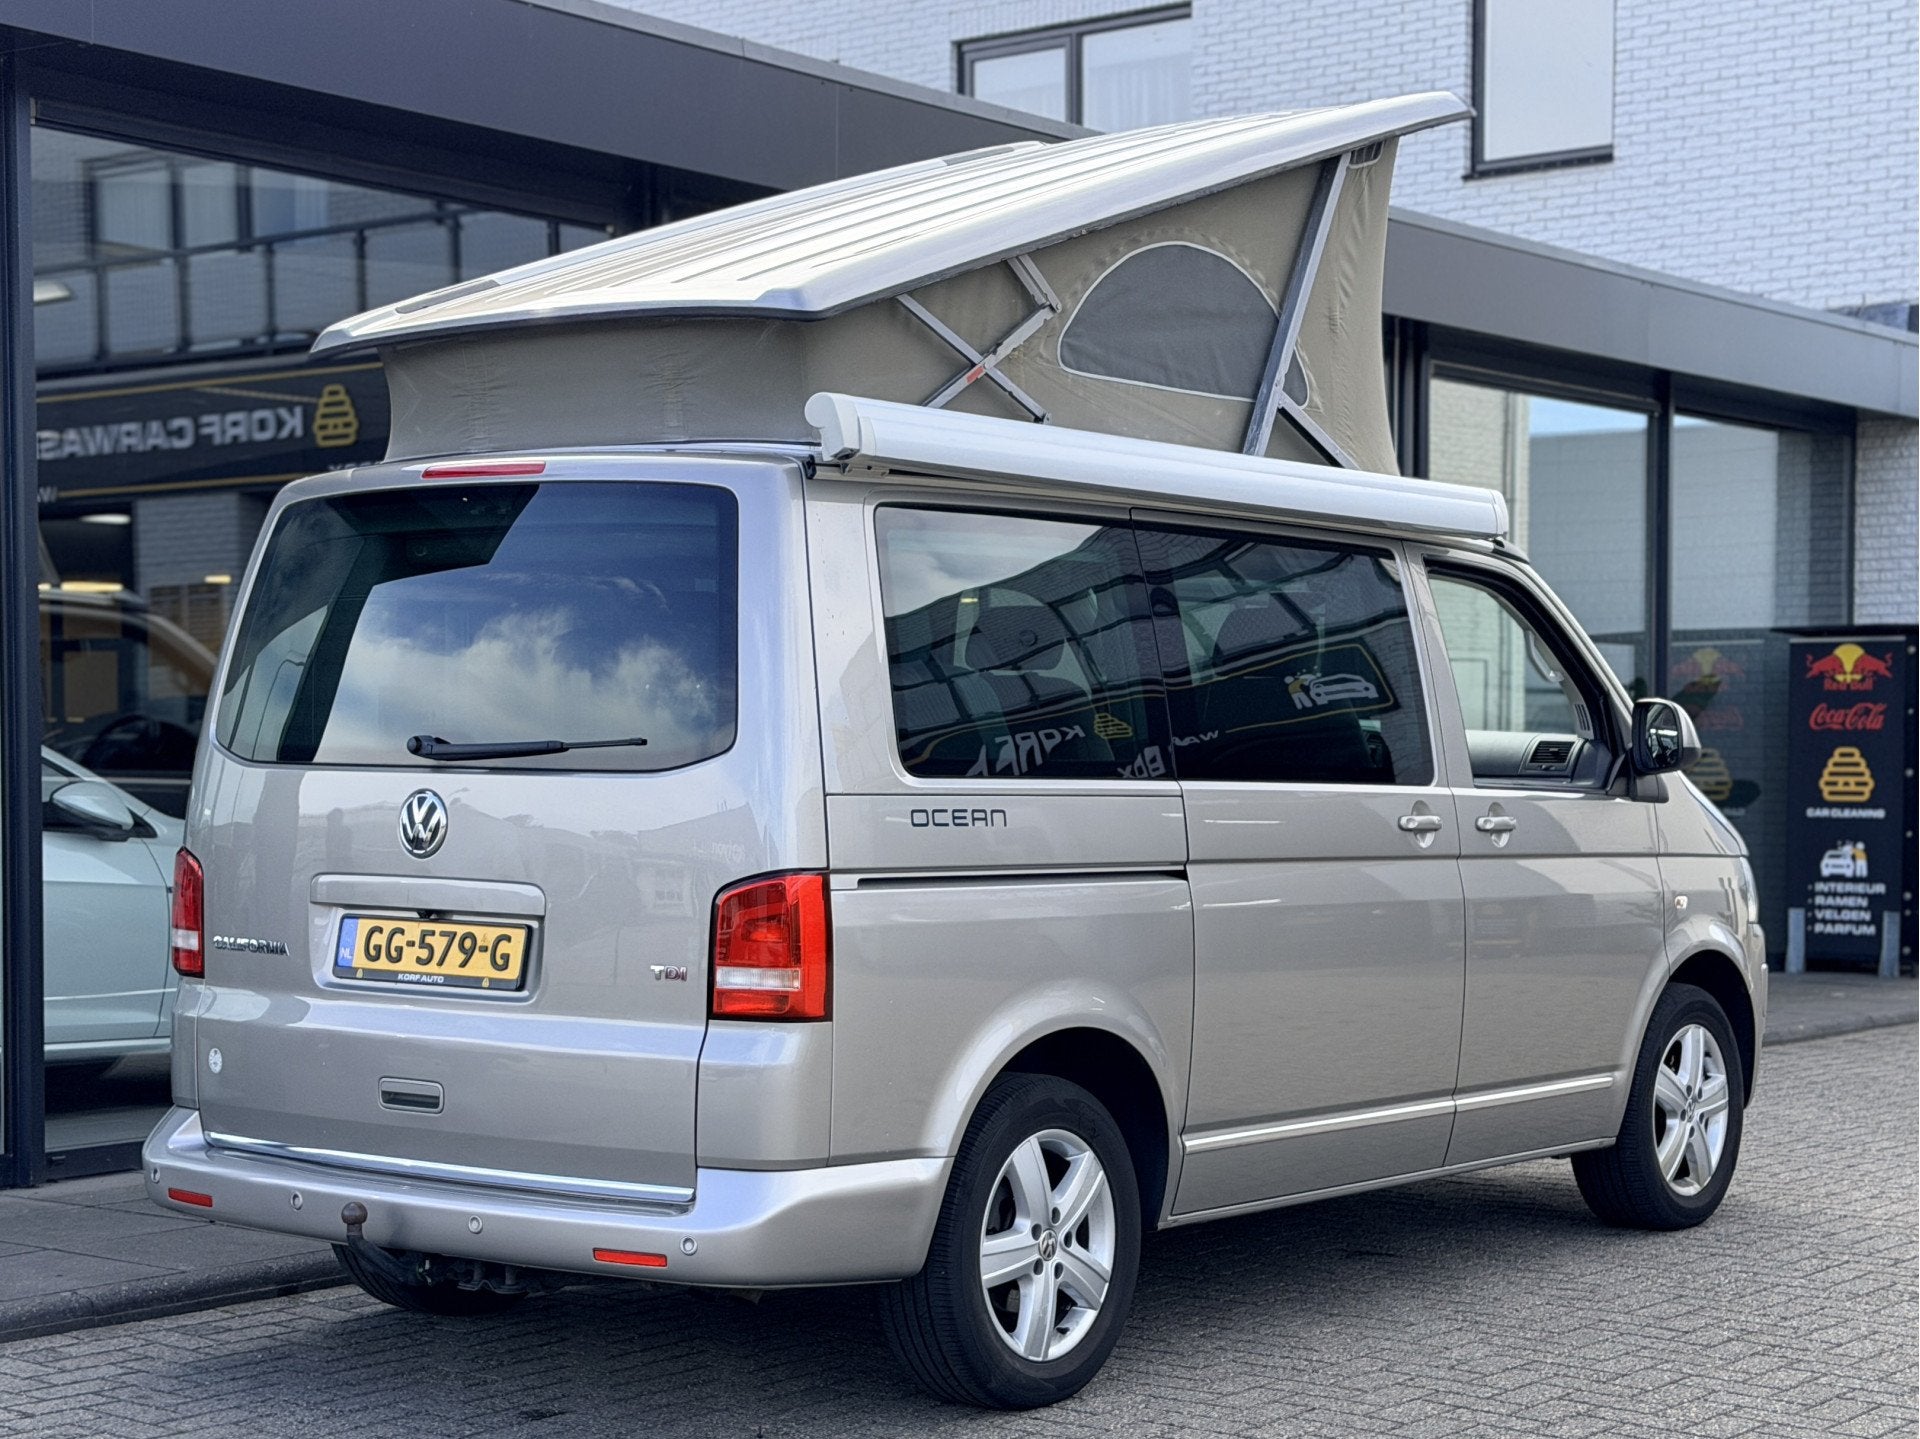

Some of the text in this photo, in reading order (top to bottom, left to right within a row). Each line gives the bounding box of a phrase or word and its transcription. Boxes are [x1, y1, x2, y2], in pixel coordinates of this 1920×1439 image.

[1809, 702, 1887, 730] Coca-Cola
[910, 809, 1007, 828] OCEAN
[1805, 807, 1886, 819] CAR CLEANING
[1814, 881, 1886, 895] INTERIEUR
[1814, 895, 1869, 908] RAMEN
[1814, 922, 1876, 936] PARFUM
[212, 935, 290, 957] CALIFORNIA
[339, 925, 513, 972] NL GG-579-G
[397, 973, 444, 984] KORF AUTO
[650, 964, 688, 982] TDI
